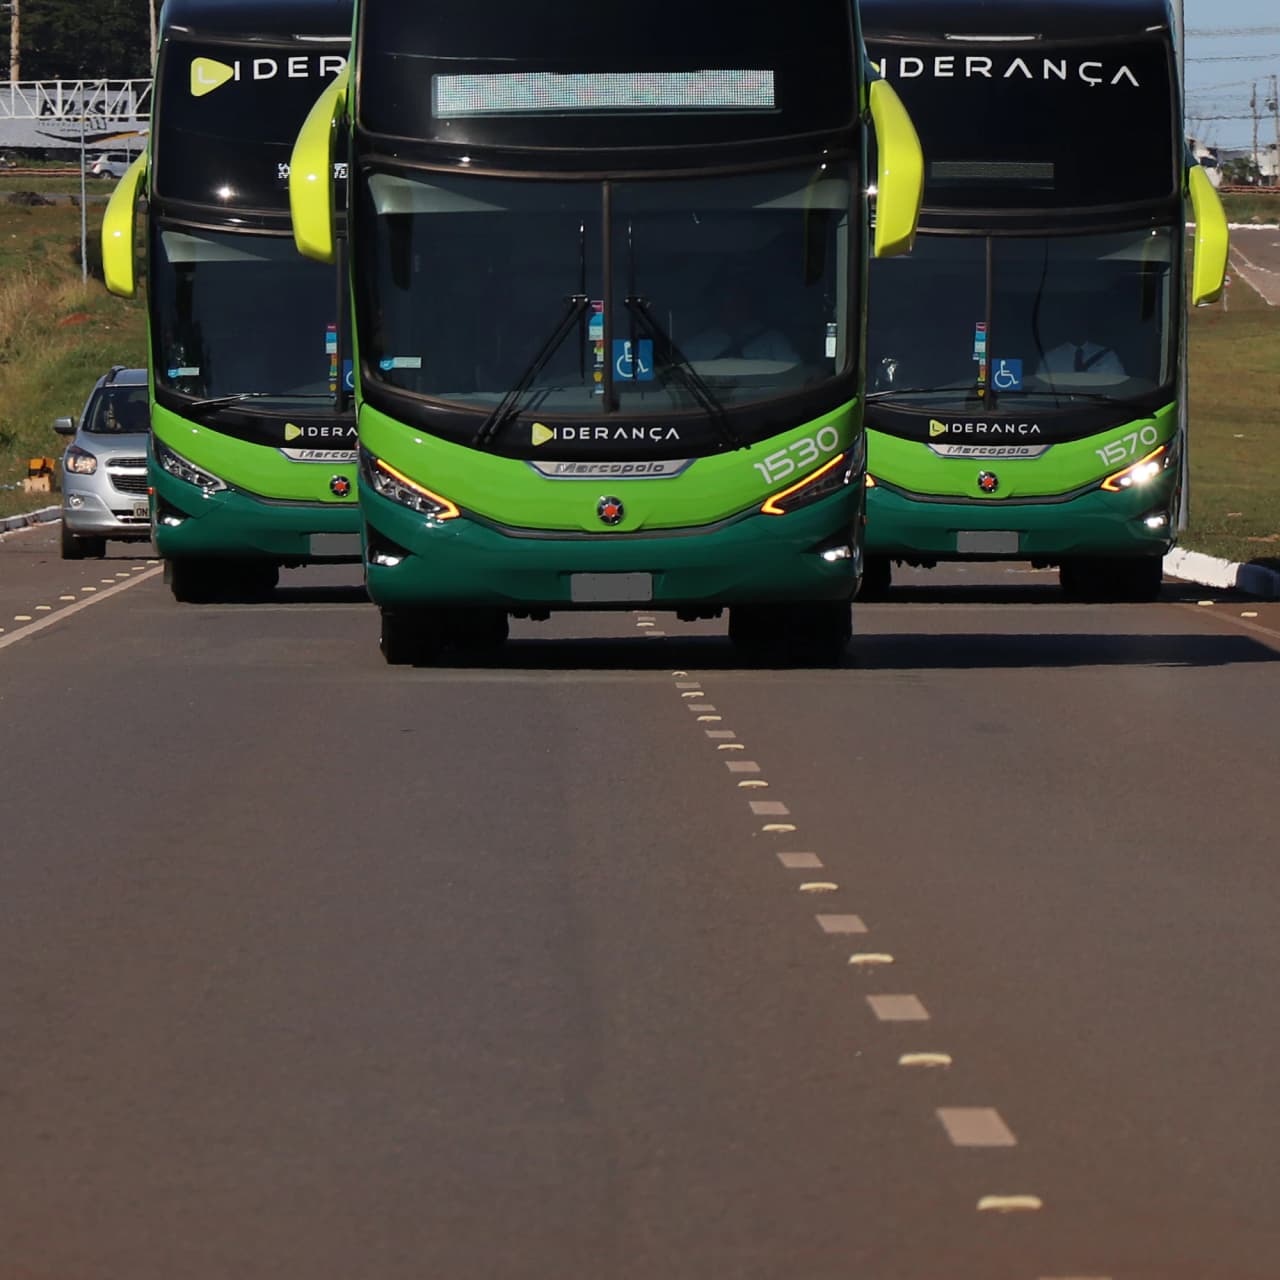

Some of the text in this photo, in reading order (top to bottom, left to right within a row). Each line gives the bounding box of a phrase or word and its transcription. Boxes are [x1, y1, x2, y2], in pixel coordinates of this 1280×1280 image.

[535, 427, 680, 442] LIDERANÇA
[931, 423, 1041, 435] LIDERANÇA
[946, 445, 1030, 456] Marcopolo
[1095, 426, 1158, 467] 1570
[753, 426, 839, 485] 1530
[554, 462, 665, 475] Marcopolo
